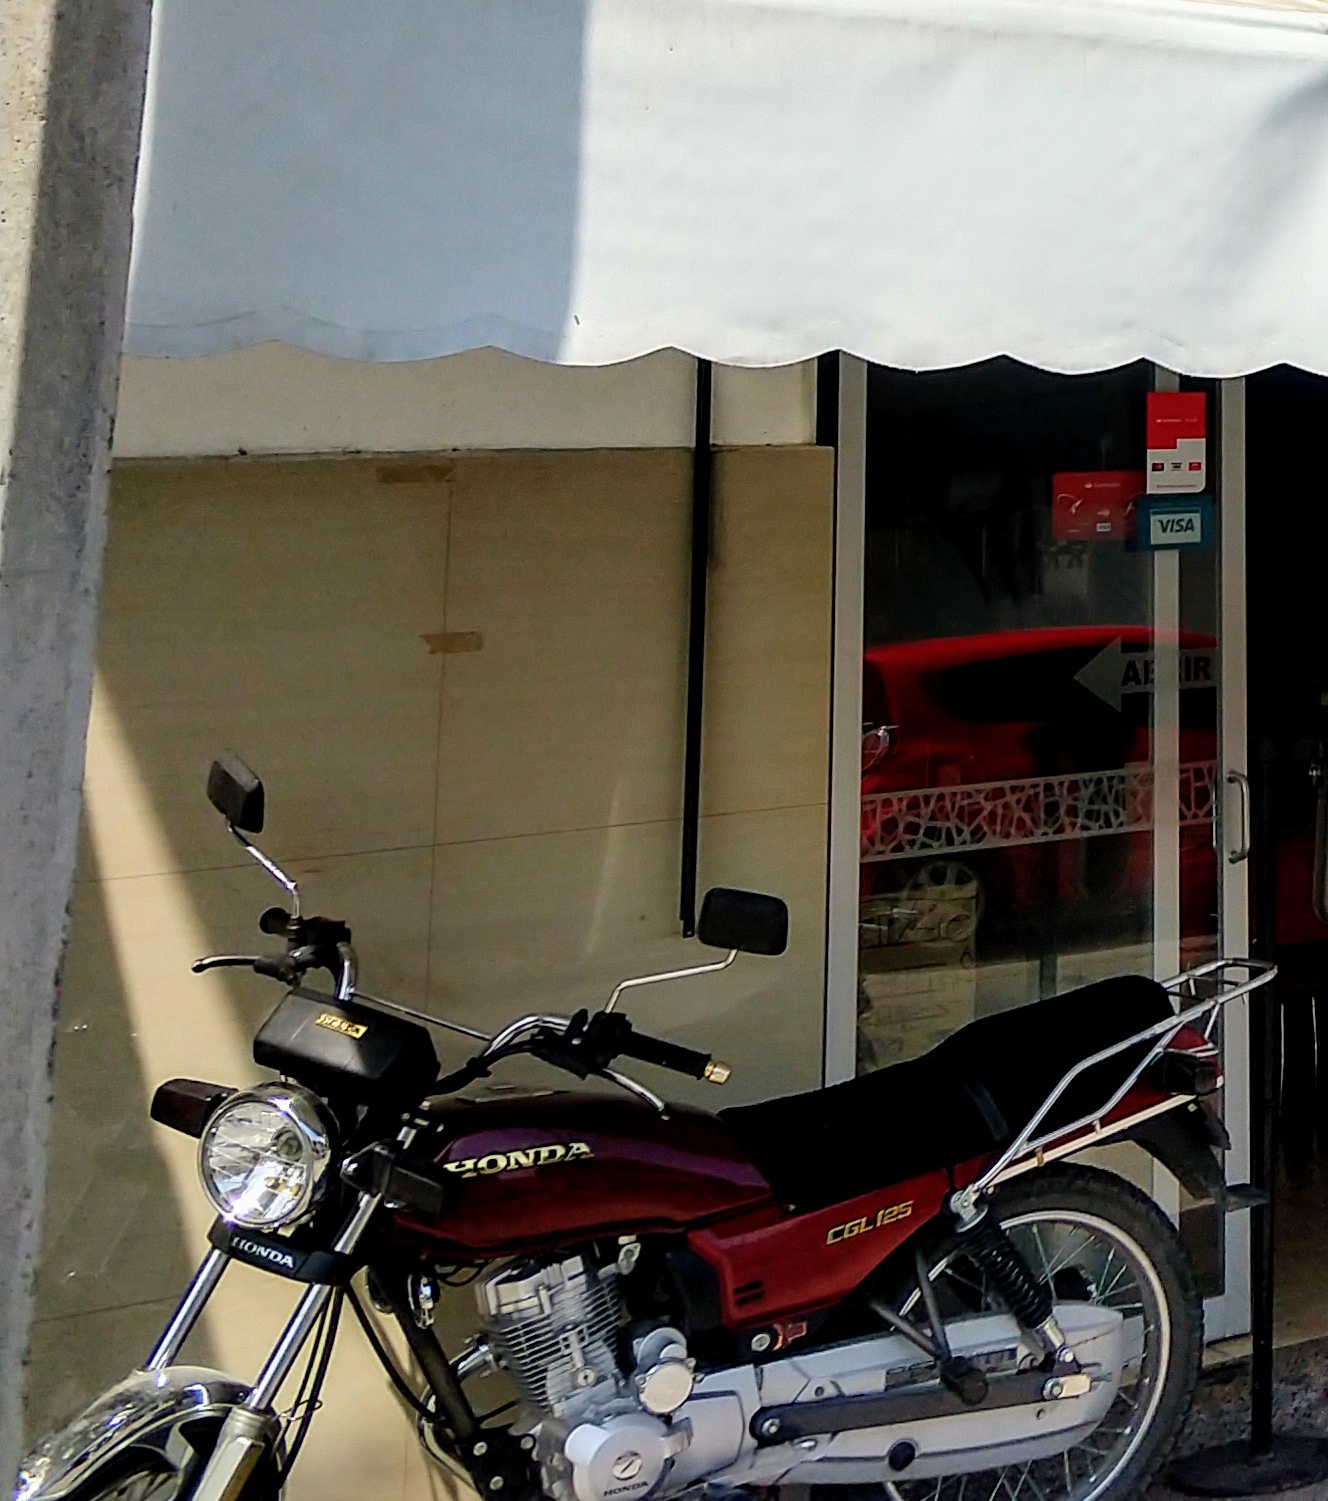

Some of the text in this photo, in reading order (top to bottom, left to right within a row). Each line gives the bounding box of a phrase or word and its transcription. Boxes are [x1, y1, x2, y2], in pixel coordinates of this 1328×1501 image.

[1157, 518, 1196, 534] VISA
[1121, 656, 1212, 687] ABIR
[442, 1142, 595, 1179] HONDA
[231, 1236, 294, 1269] HONDA
[603, 1481, 649, 1497] HONDA
